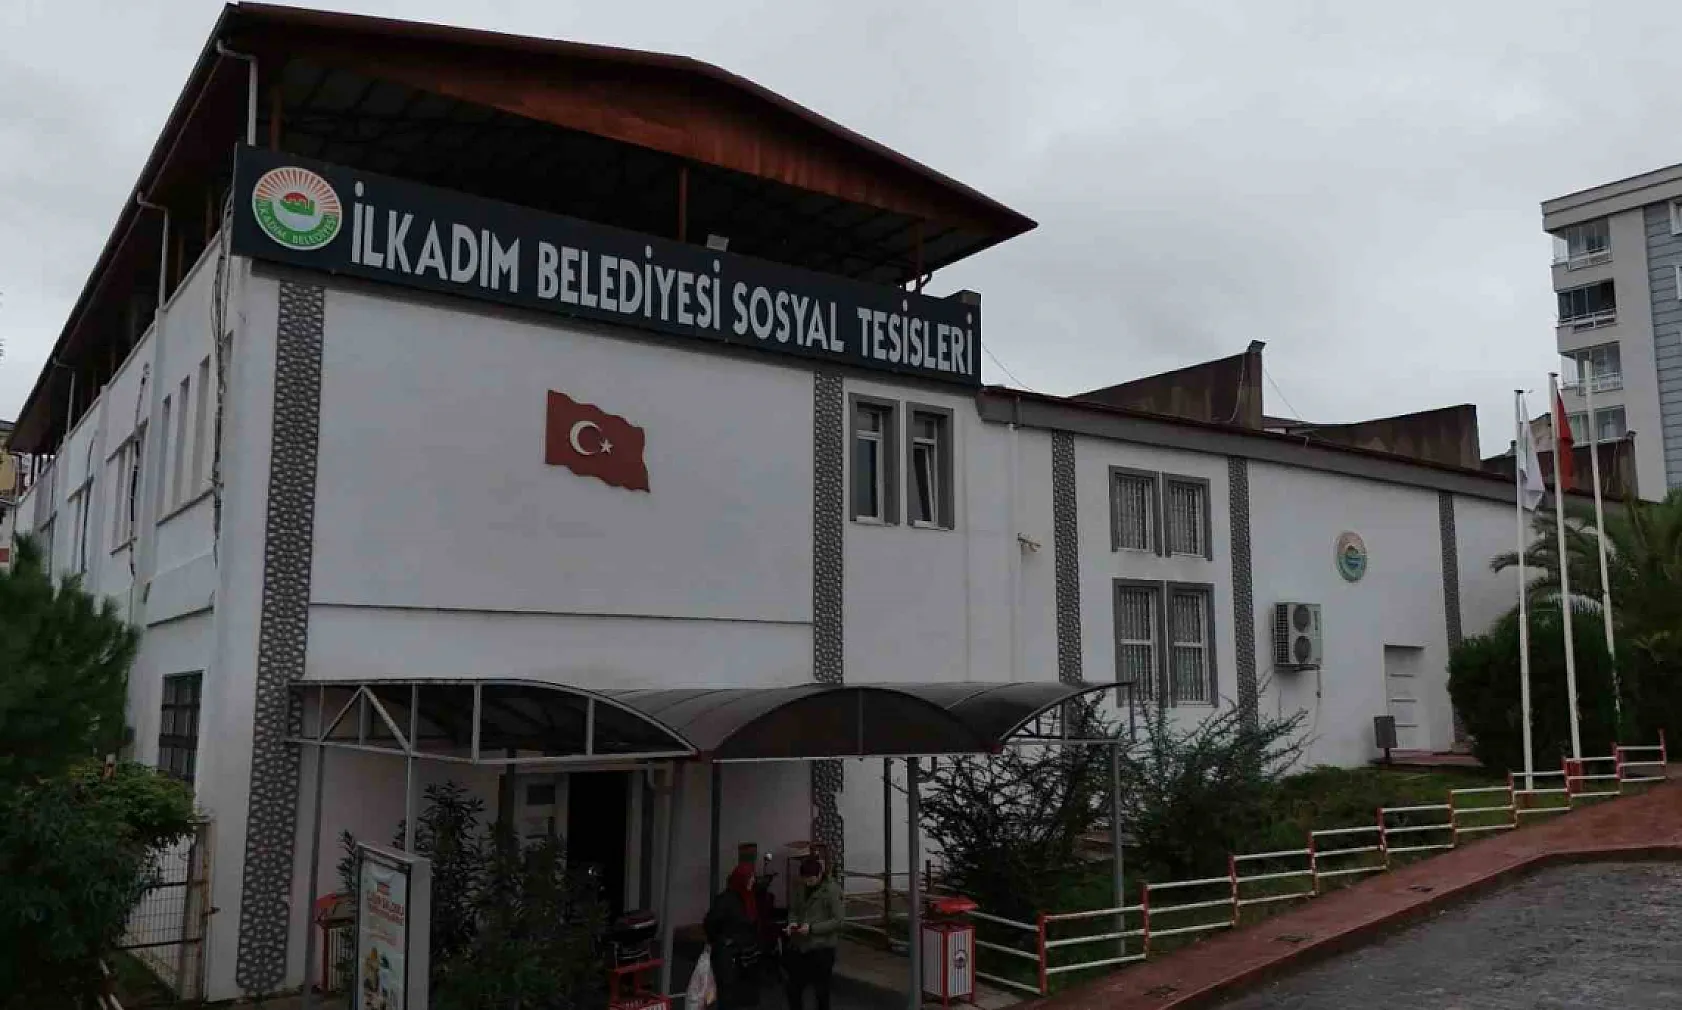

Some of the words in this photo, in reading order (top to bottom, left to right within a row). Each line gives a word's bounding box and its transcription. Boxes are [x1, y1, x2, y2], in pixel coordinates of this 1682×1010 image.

[351, 180, 520, 294] İLKADIM
[537, 241, 721, 331] BELEDİYESİ
[732, 281, 845, 353] SOSYAL
[856, 299, 973, 375] TESİSLERİ
